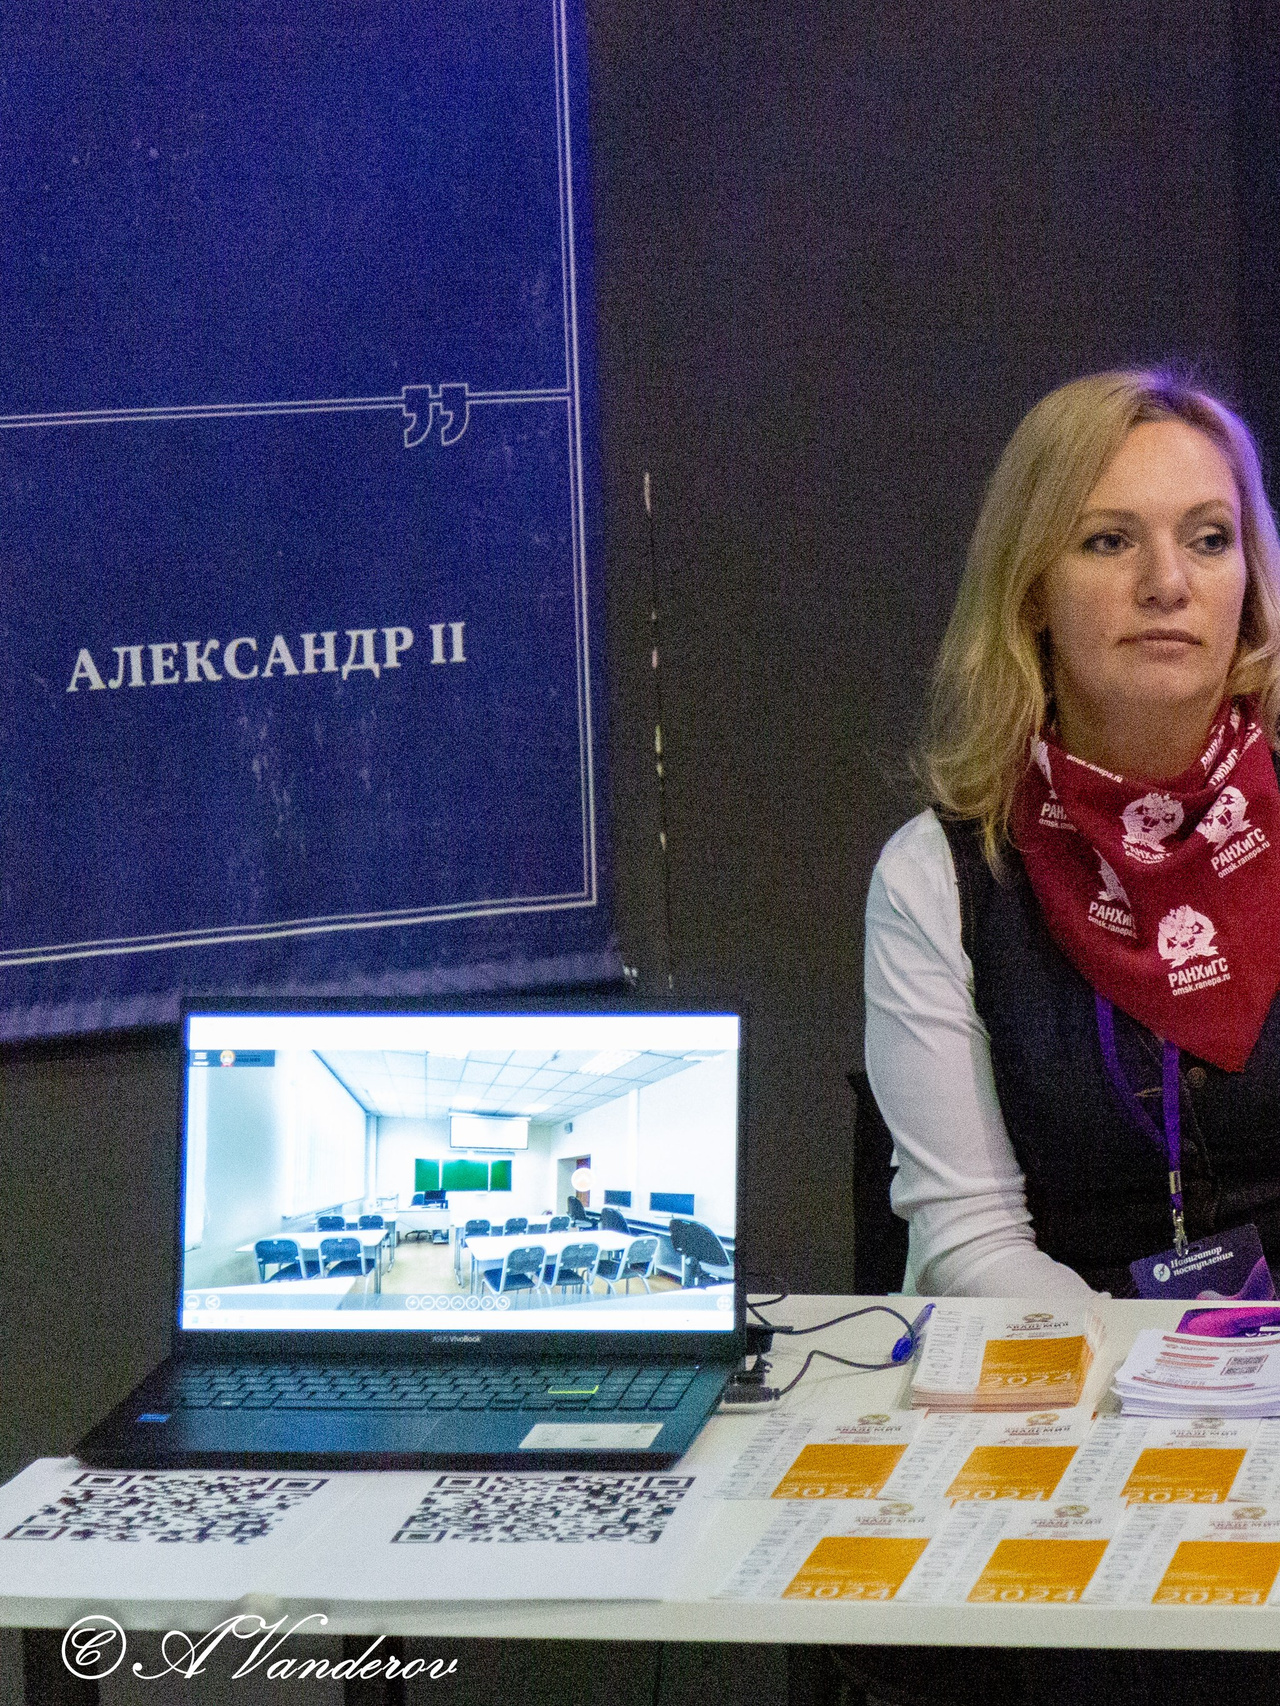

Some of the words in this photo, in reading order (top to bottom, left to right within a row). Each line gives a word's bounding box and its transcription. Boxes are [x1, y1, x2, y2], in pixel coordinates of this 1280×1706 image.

[66, 625, 415, 692] АЛЕКСАНДР
[1211, 828, 1265, 870] РАНХиГС
[1218, 841, 1270, 878] omsk.ranepa.ru
[1168, 957, 1228, 987] РАНХиГС
[1172, 973, 1230, 996] omsk.ranepa.ru
